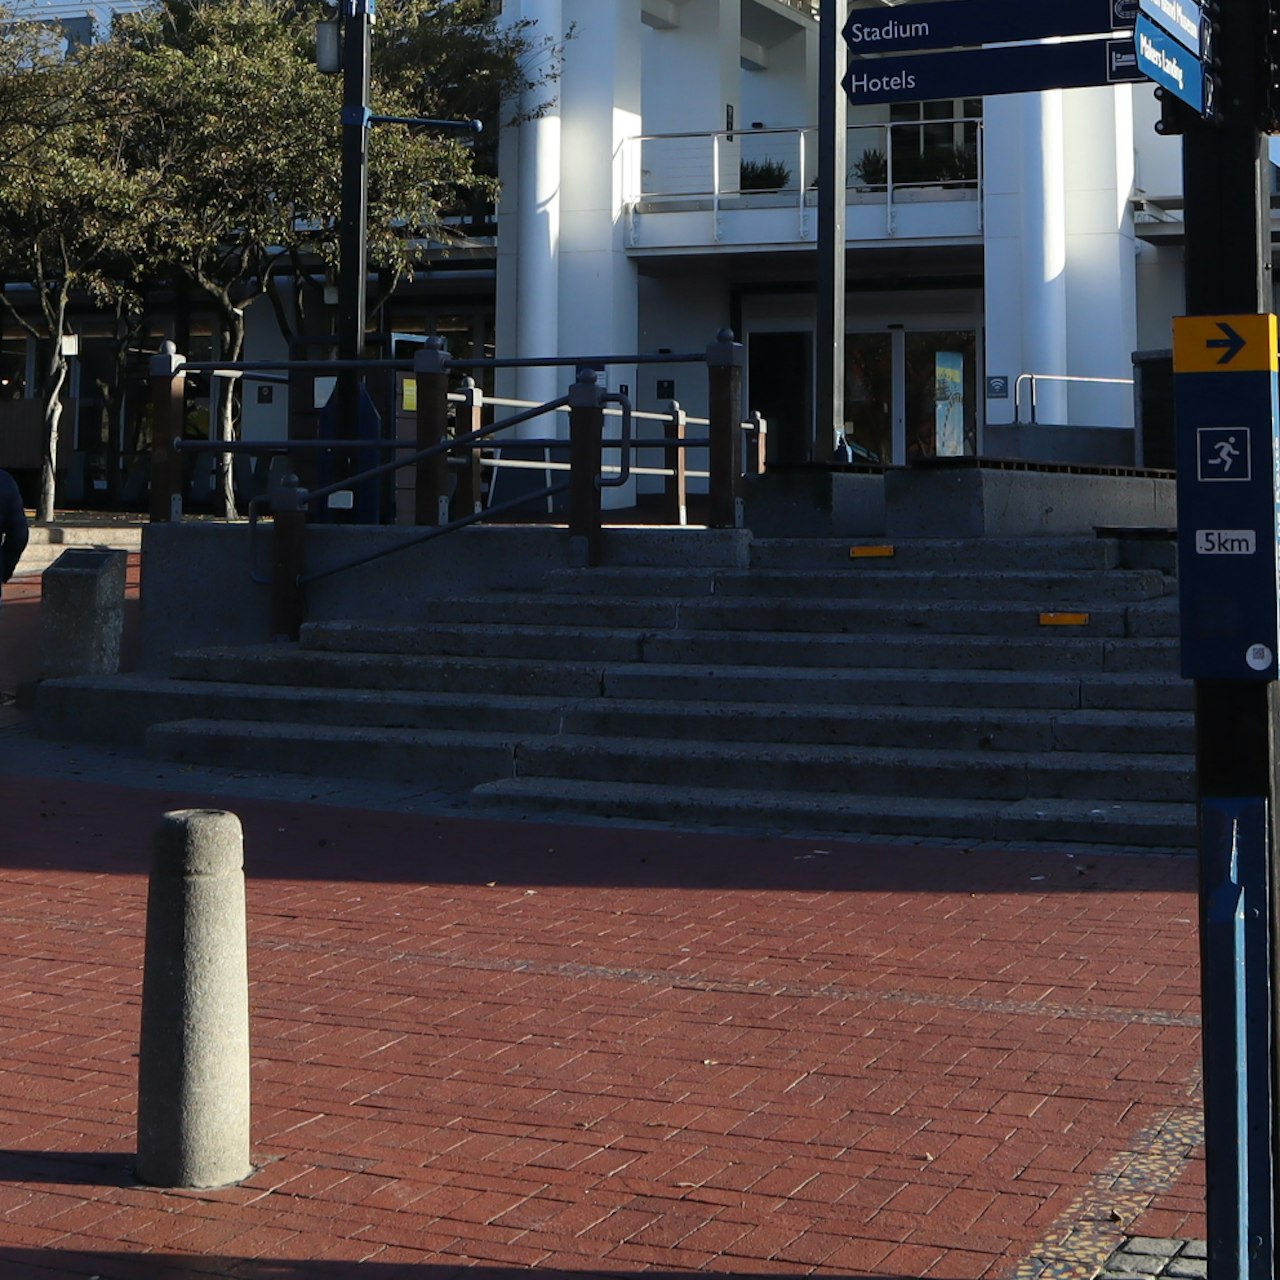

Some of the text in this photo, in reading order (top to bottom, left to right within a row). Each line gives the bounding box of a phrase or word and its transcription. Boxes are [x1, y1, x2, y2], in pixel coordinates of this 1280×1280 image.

[852, 19, 930, 42] Stadium
[1140, 32, 1184, 90] Makers Landing
[851, 70, 916, 94] Hotels
[1199, 532, 1250, 554] .5km
